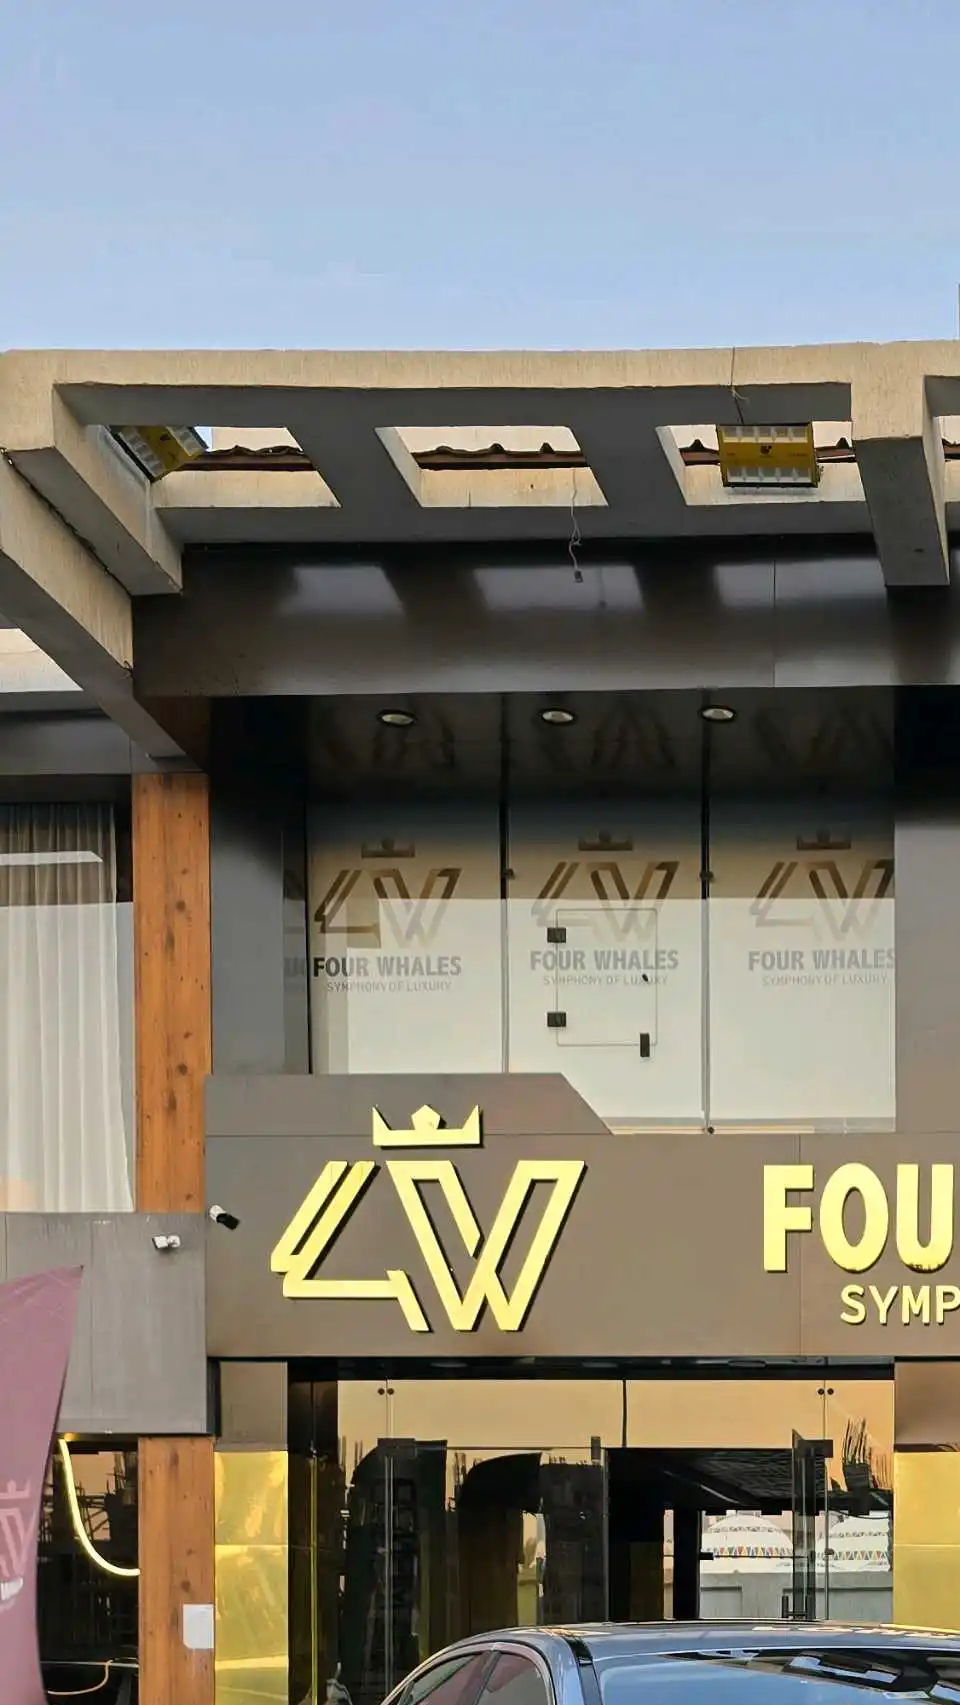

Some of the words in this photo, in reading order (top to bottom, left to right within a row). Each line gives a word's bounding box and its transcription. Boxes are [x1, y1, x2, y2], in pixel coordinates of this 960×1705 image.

[313, 957, 370, 977] FOUR
[376, 956, 462, 977] WHALES
[530, 950, 586, 971] FOUR
[594, 949, 679, 971] WHALES
[748, 951, 804, 971] FOUR
[812, 949, 895, 970] WHALES
